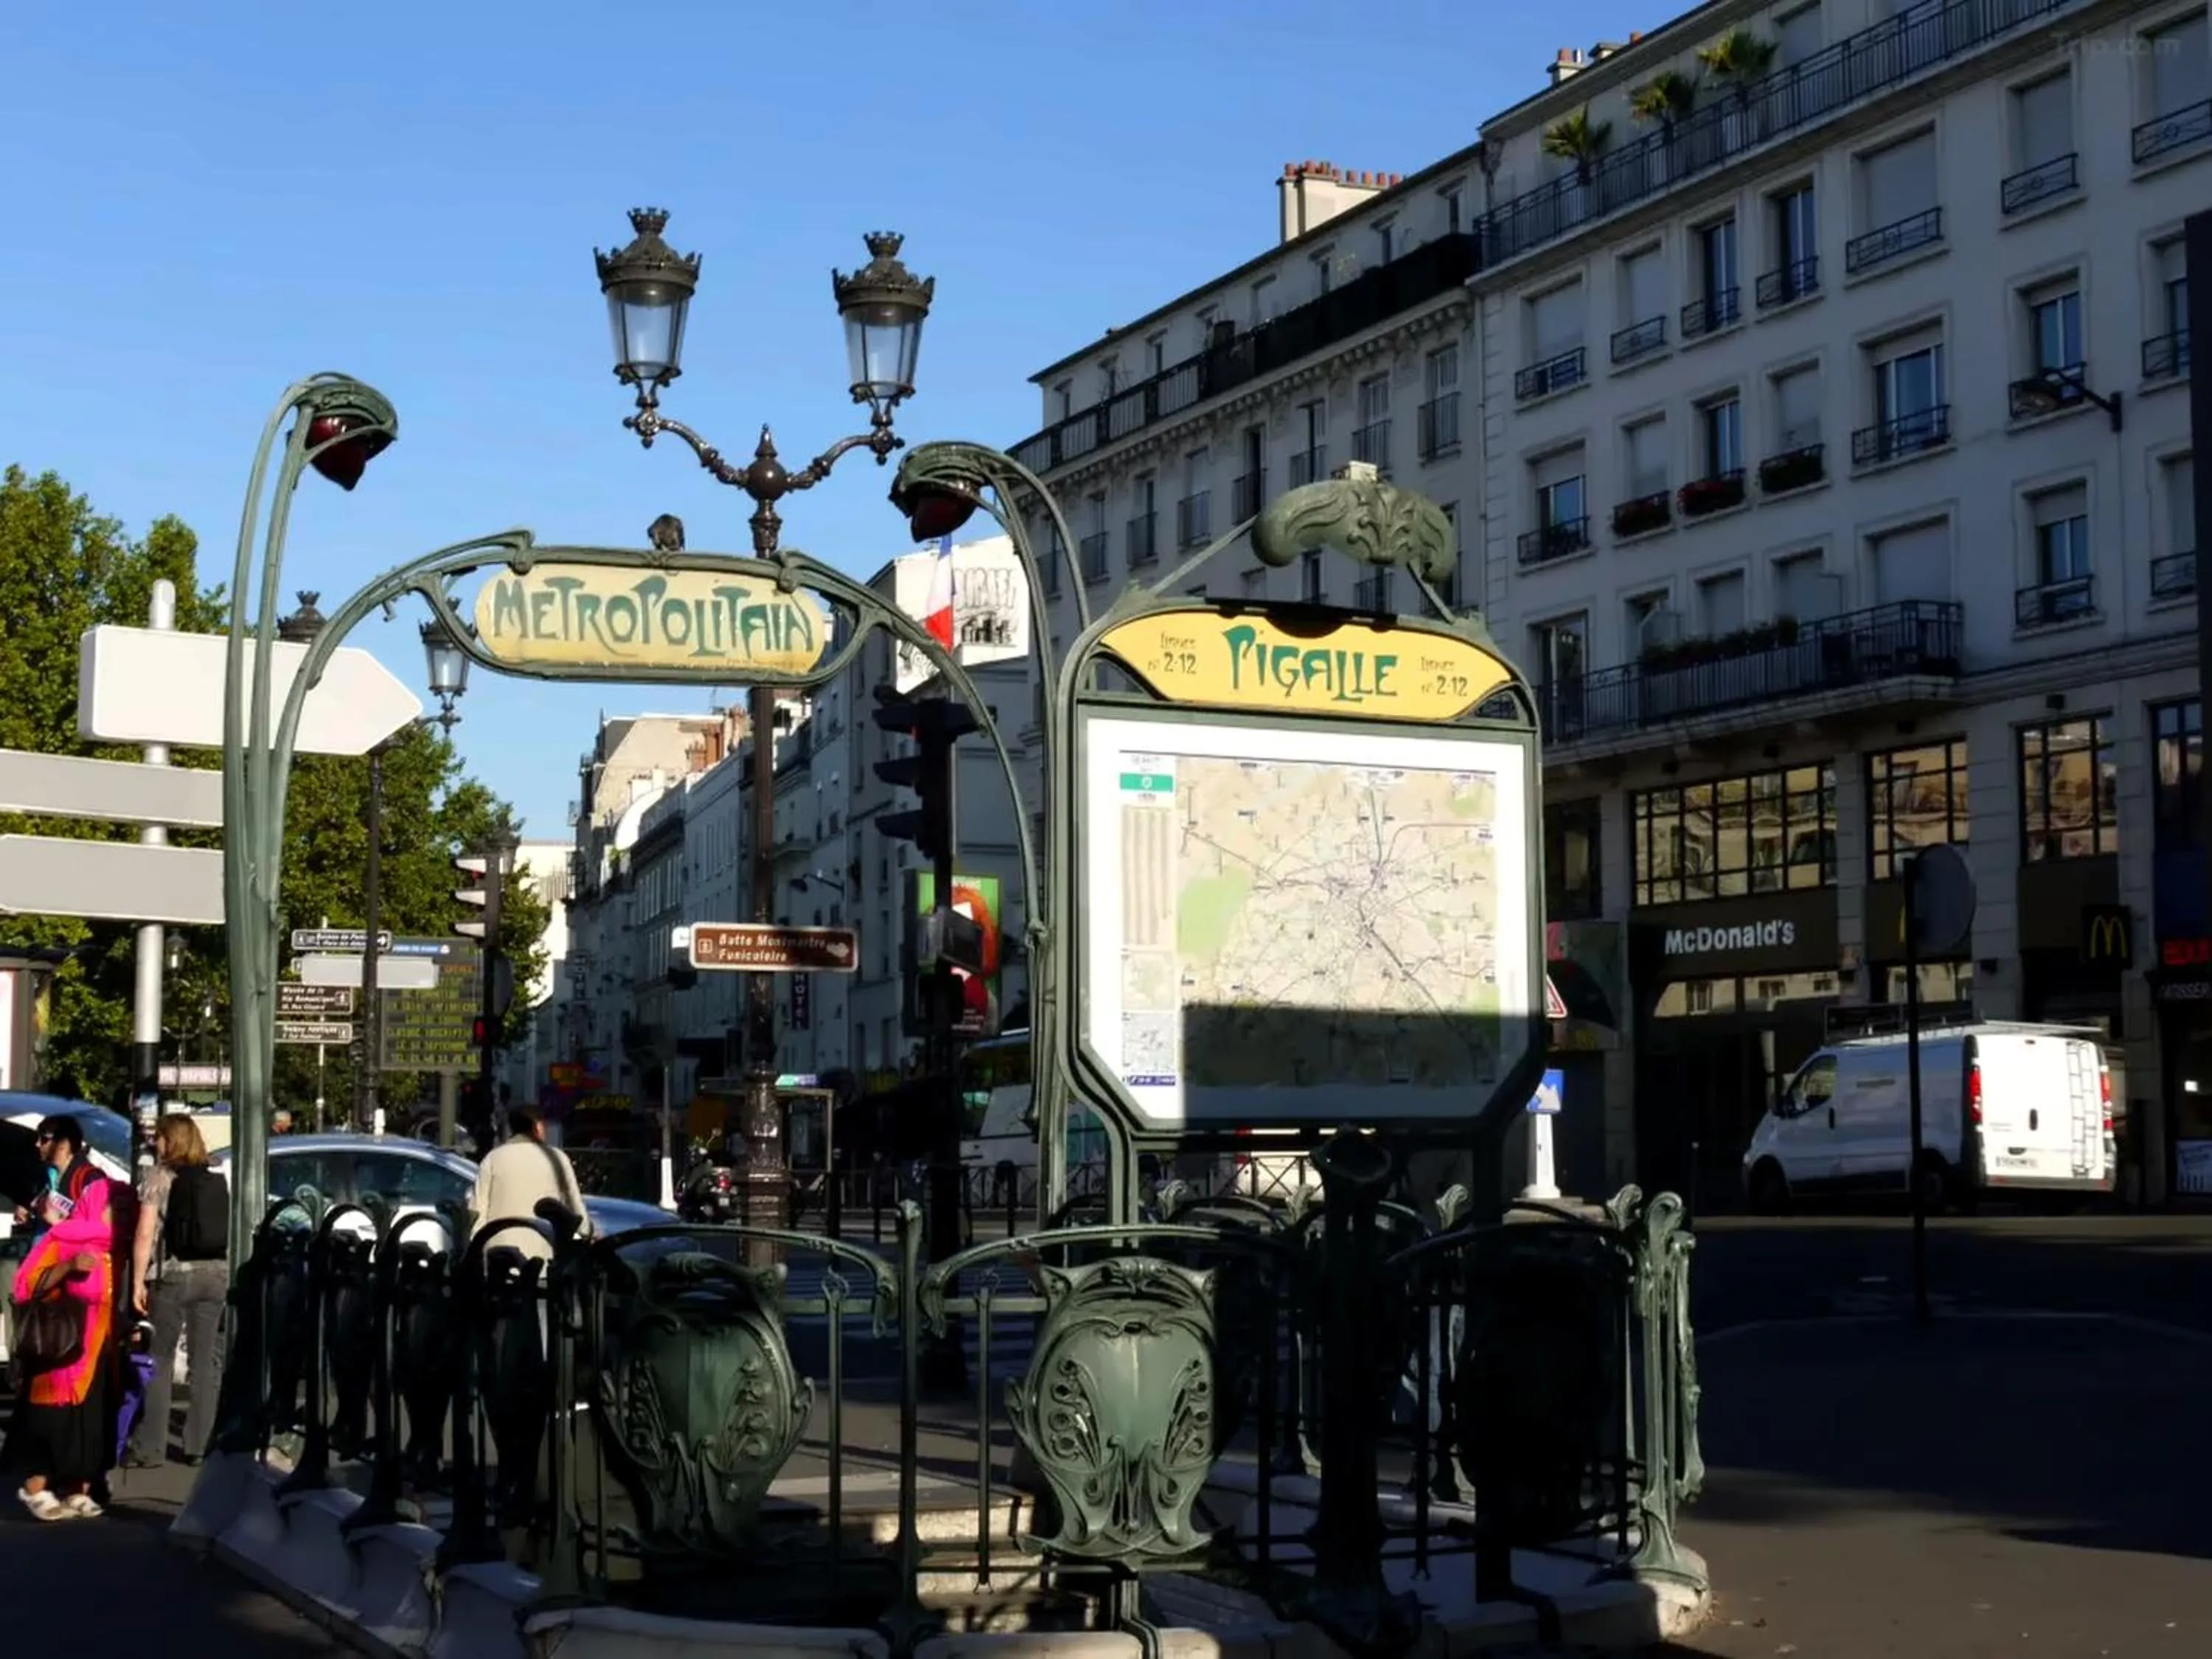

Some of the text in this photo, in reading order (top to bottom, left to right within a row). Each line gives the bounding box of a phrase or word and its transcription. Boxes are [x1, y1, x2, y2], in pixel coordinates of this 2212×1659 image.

[493, 574, 814, 659] METROPOLITAIN
[1224, 625, 1399, 702] PIGALLE
[719, 932, 753, 947] Butte
[1664, 919, 1796, 956] McDonald's
